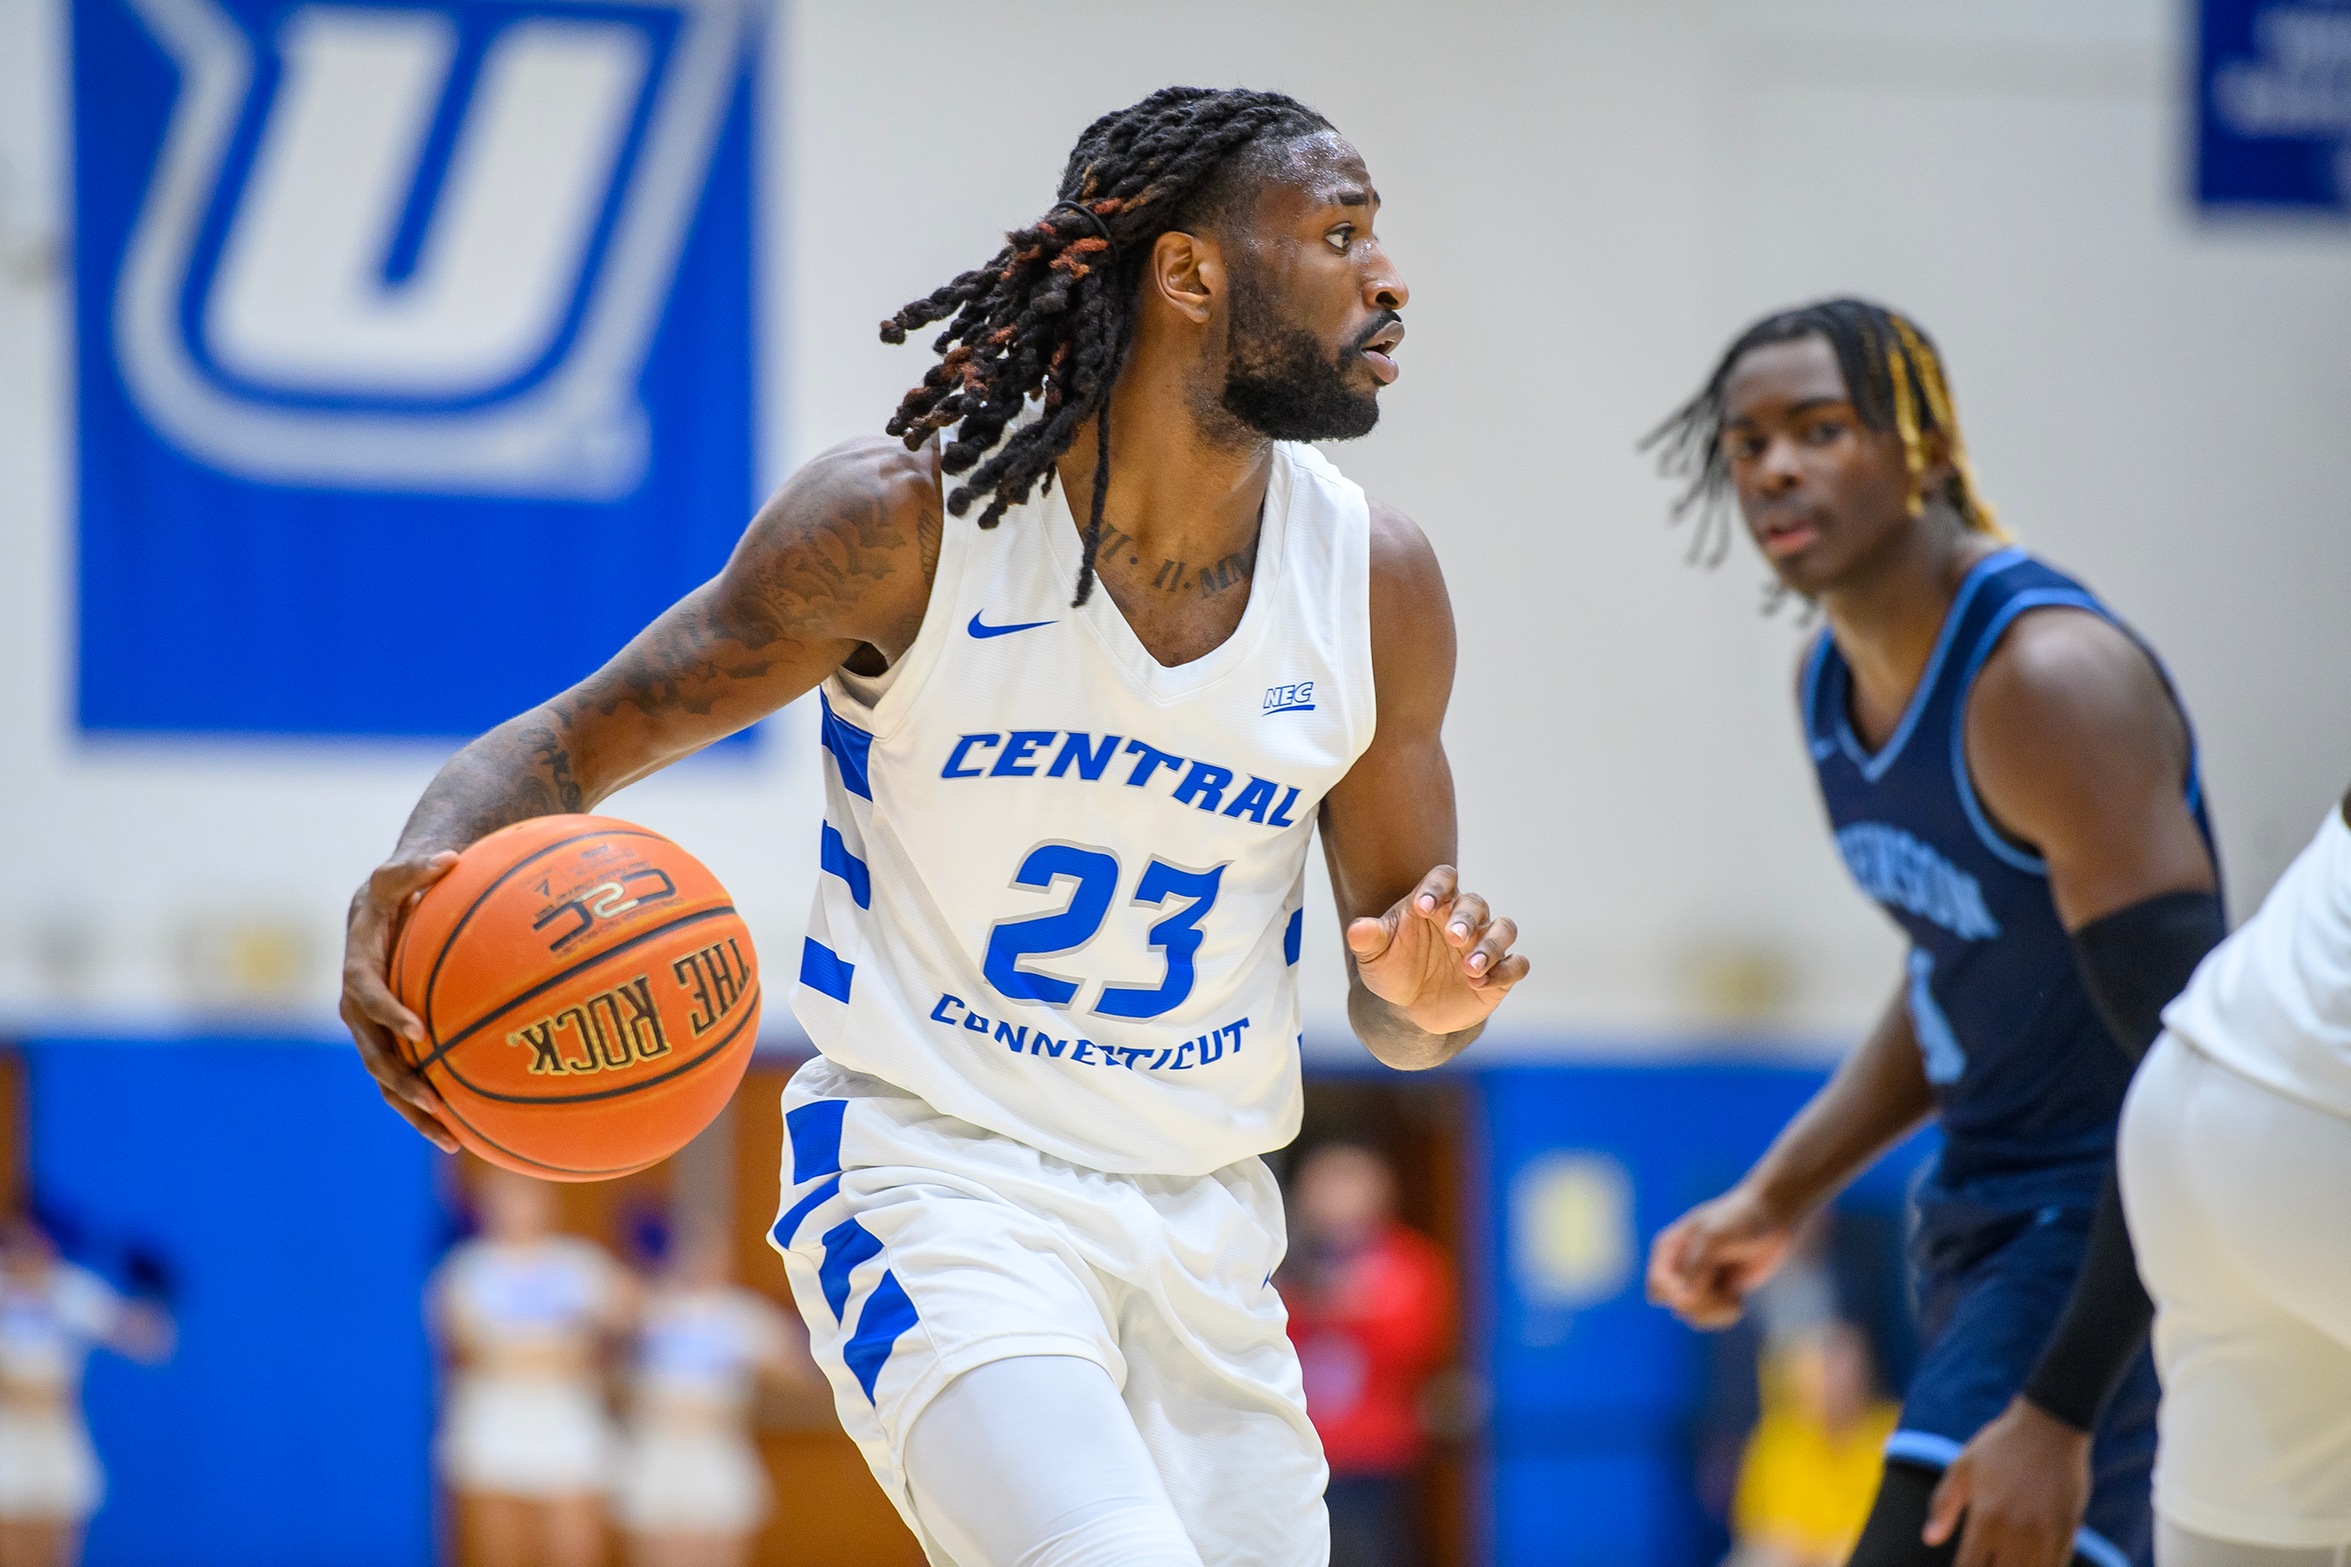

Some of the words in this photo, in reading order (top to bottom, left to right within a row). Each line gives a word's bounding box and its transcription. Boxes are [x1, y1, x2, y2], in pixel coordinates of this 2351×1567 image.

[1263, 681, 1314, 709] NEC
[939, 728, 1303, 828] CENTRAL
[981, 837, 1237, 1025] 23
[516, 975, 673, 1076] ROCK
[672, 937, 752, 1039] THE
